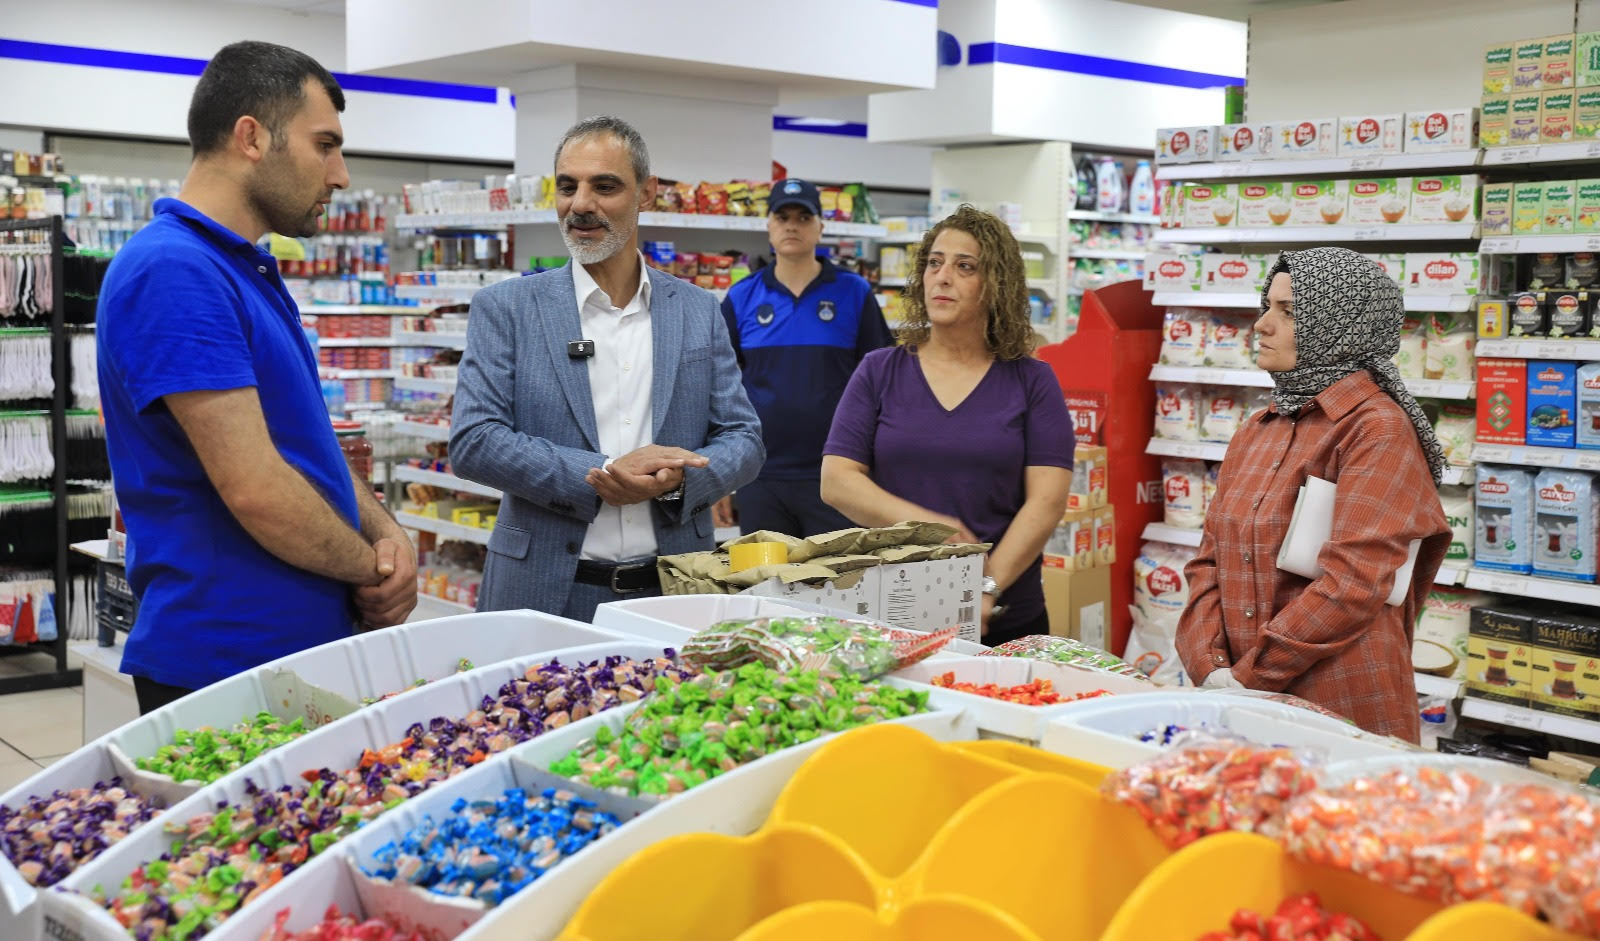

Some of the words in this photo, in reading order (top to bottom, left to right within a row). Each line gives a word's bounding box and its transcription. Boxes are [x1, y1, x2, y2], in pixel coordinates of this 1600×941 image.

[1161, 262, 1184, 274] dilan
[1221, 262, 1247, 274] dilan
[1426, 263, 1455, 275] dilan
[1152, 570, 1172, 582] Bal
